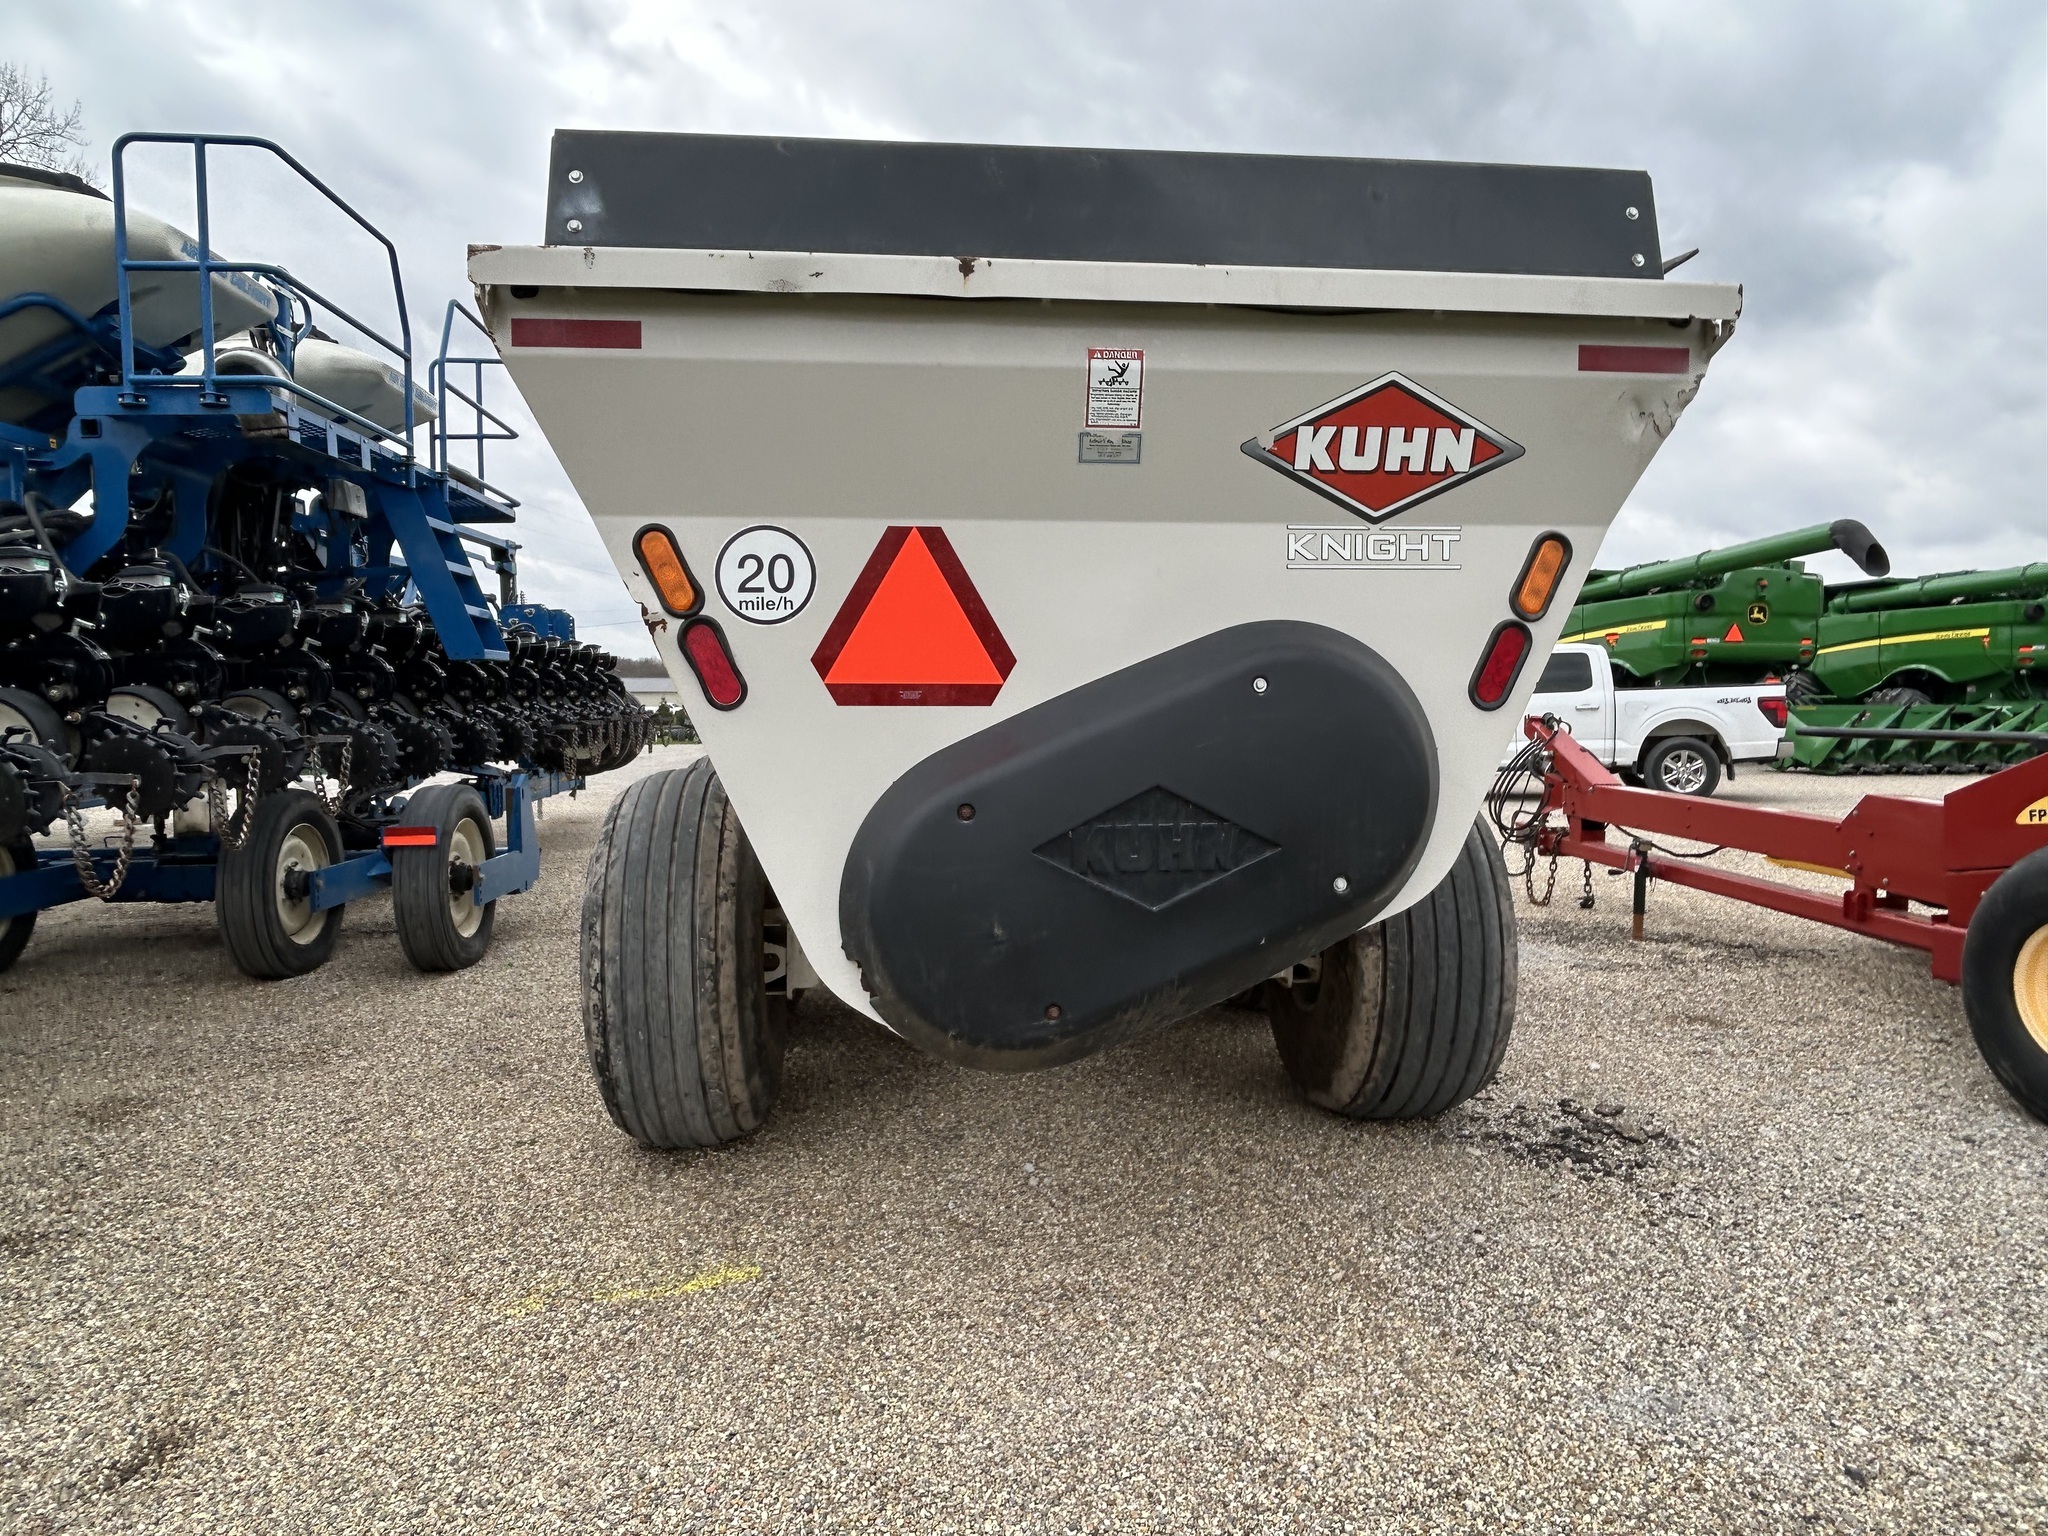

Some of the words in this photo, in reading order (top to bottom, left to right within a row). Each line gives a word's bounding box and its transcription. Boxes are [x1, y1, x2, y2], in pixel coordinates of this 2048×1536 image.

[1292, 425, 1476, 474] KUHN
[1287, 533, 1462, 562] KNIGHT
[737, 553, 795, 593] 20
[738, 596, 794, 611] mile/h
[1071, 821, 1240, 874] KUHN
